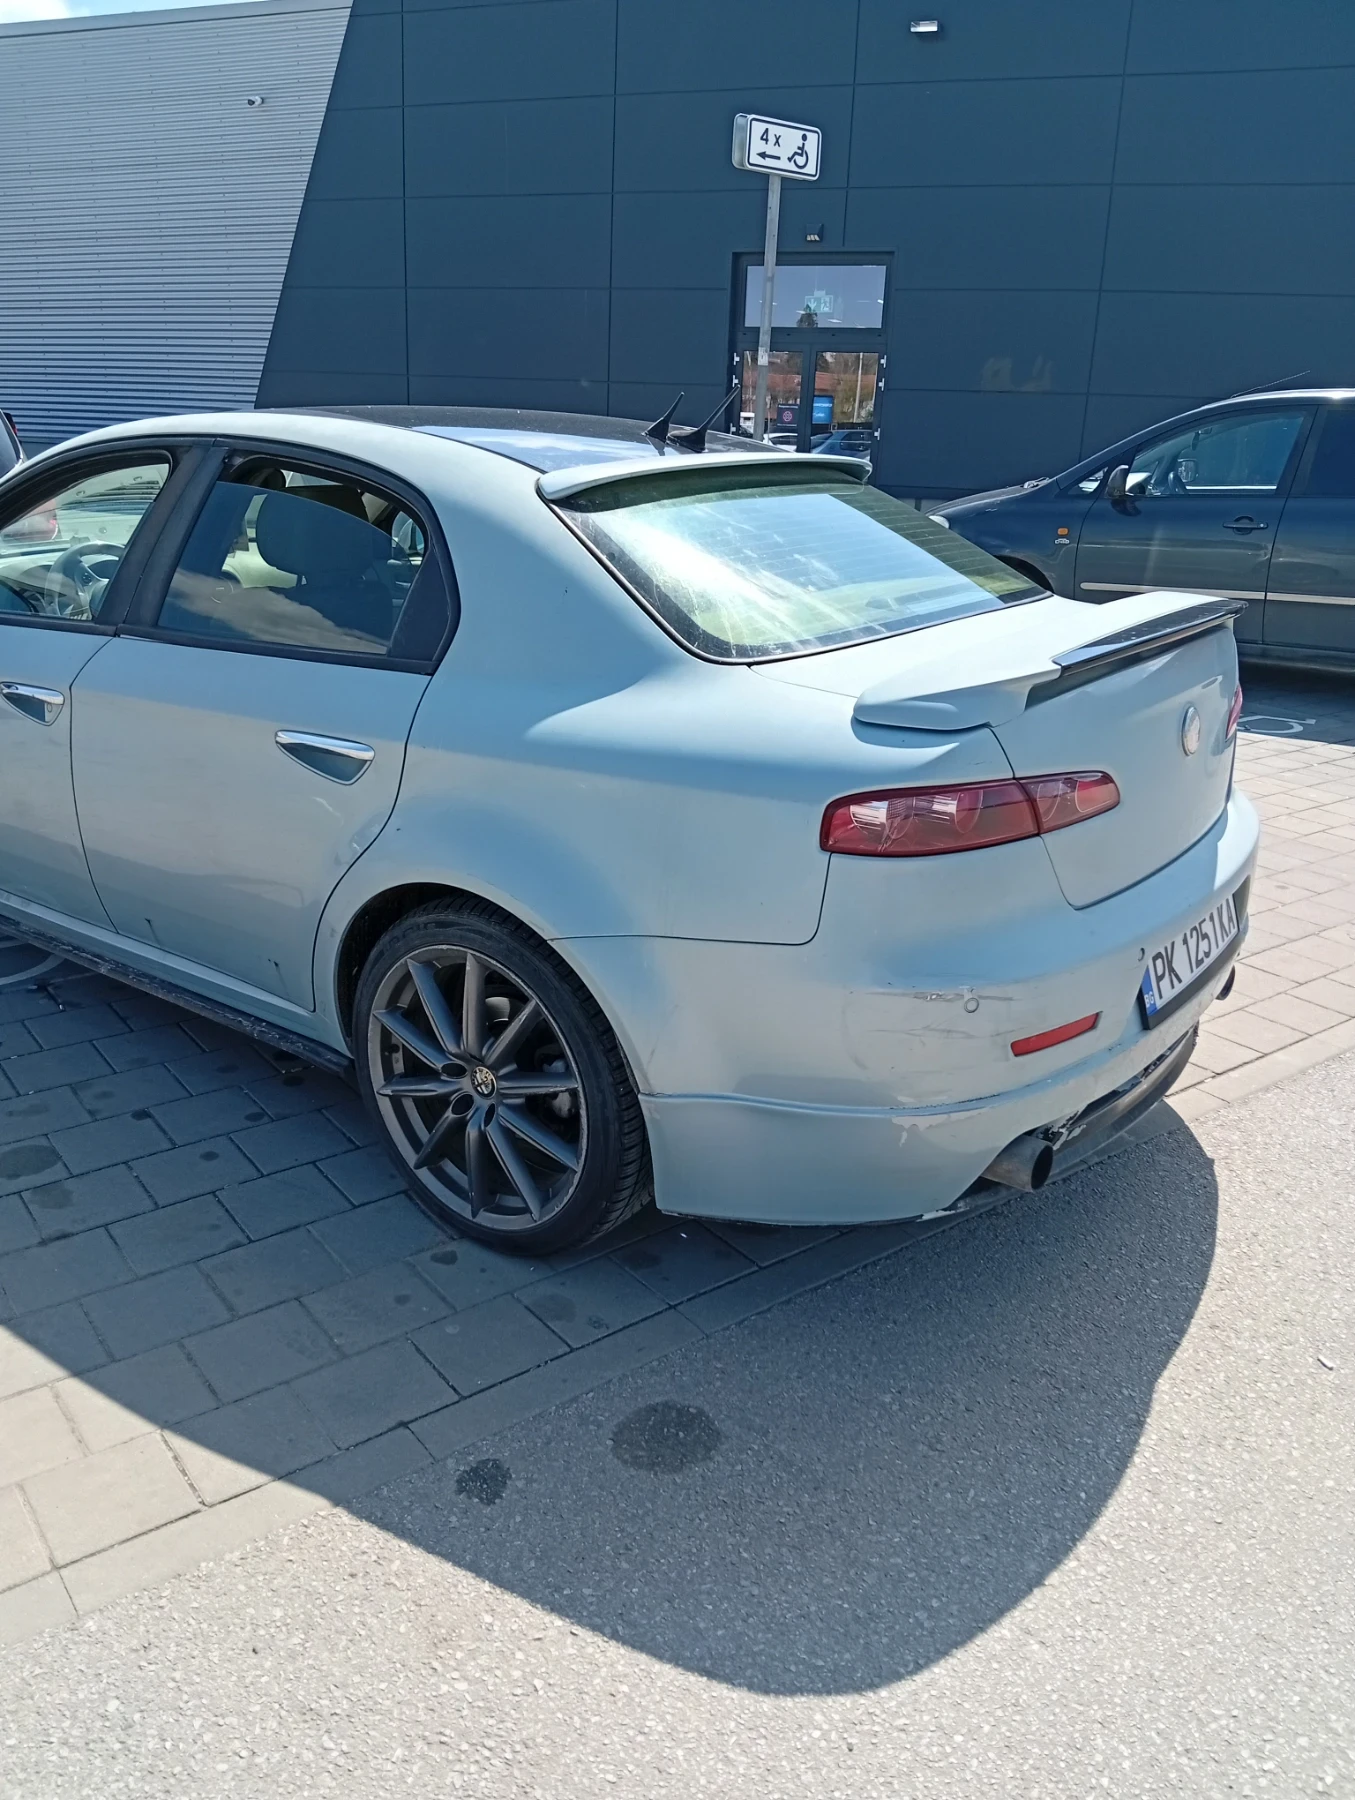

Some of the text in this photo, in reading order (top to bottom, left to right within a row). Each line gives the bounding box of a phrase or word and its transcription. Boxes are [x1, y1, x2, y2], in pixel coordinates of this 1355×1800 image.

[760, 127, 769, 145] 4
[1151, 898, 1235, 1000] PK 1251 KA
[1144, 991, 1155, 1008] BG
